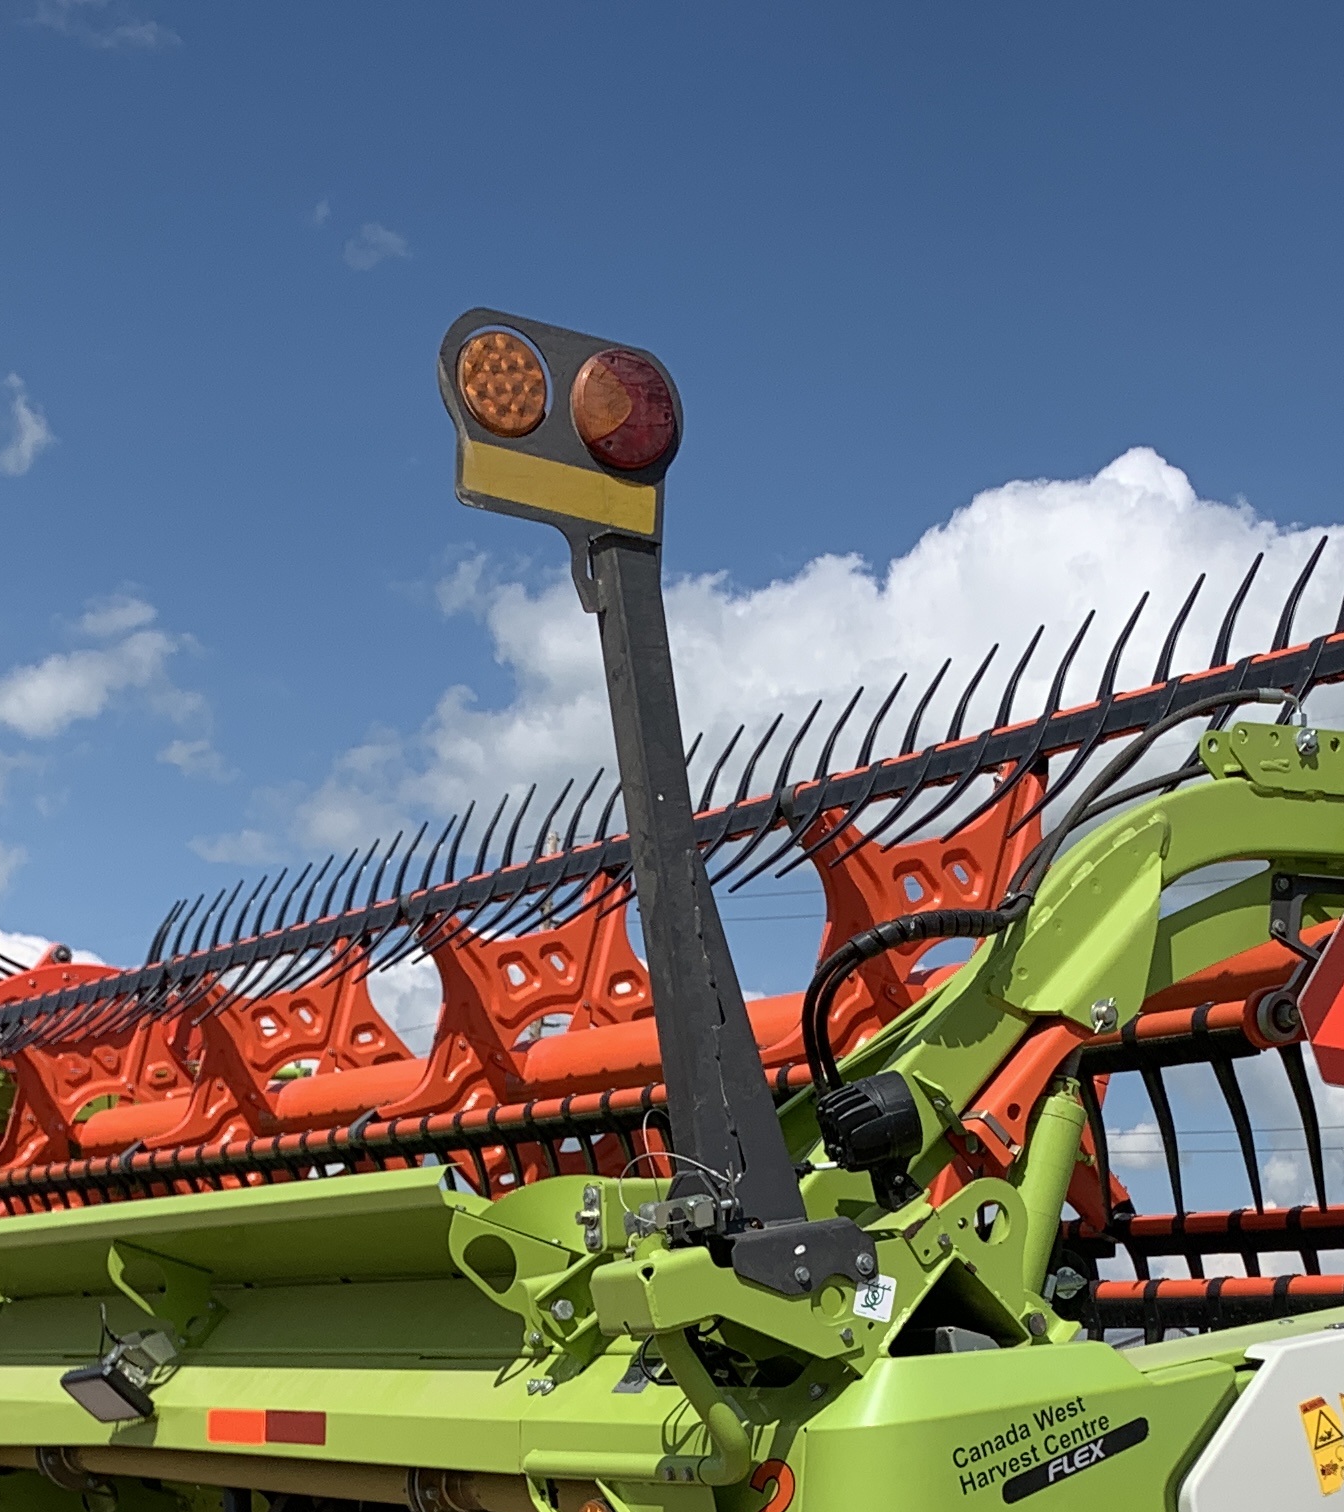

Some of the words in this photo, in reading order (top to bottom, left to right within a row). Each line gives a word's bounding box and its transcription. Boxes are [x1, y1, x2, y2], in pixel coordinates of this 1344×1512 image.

[952, 1423, 1032, 1468] Canada
[1032, 1396, 1086, 1431] West
[959, 1444, 1041, 1495] Harvest
[1043, 1415, 1109, 1455] Centre
[1048, 1438, 1106, 1483] FLEX
